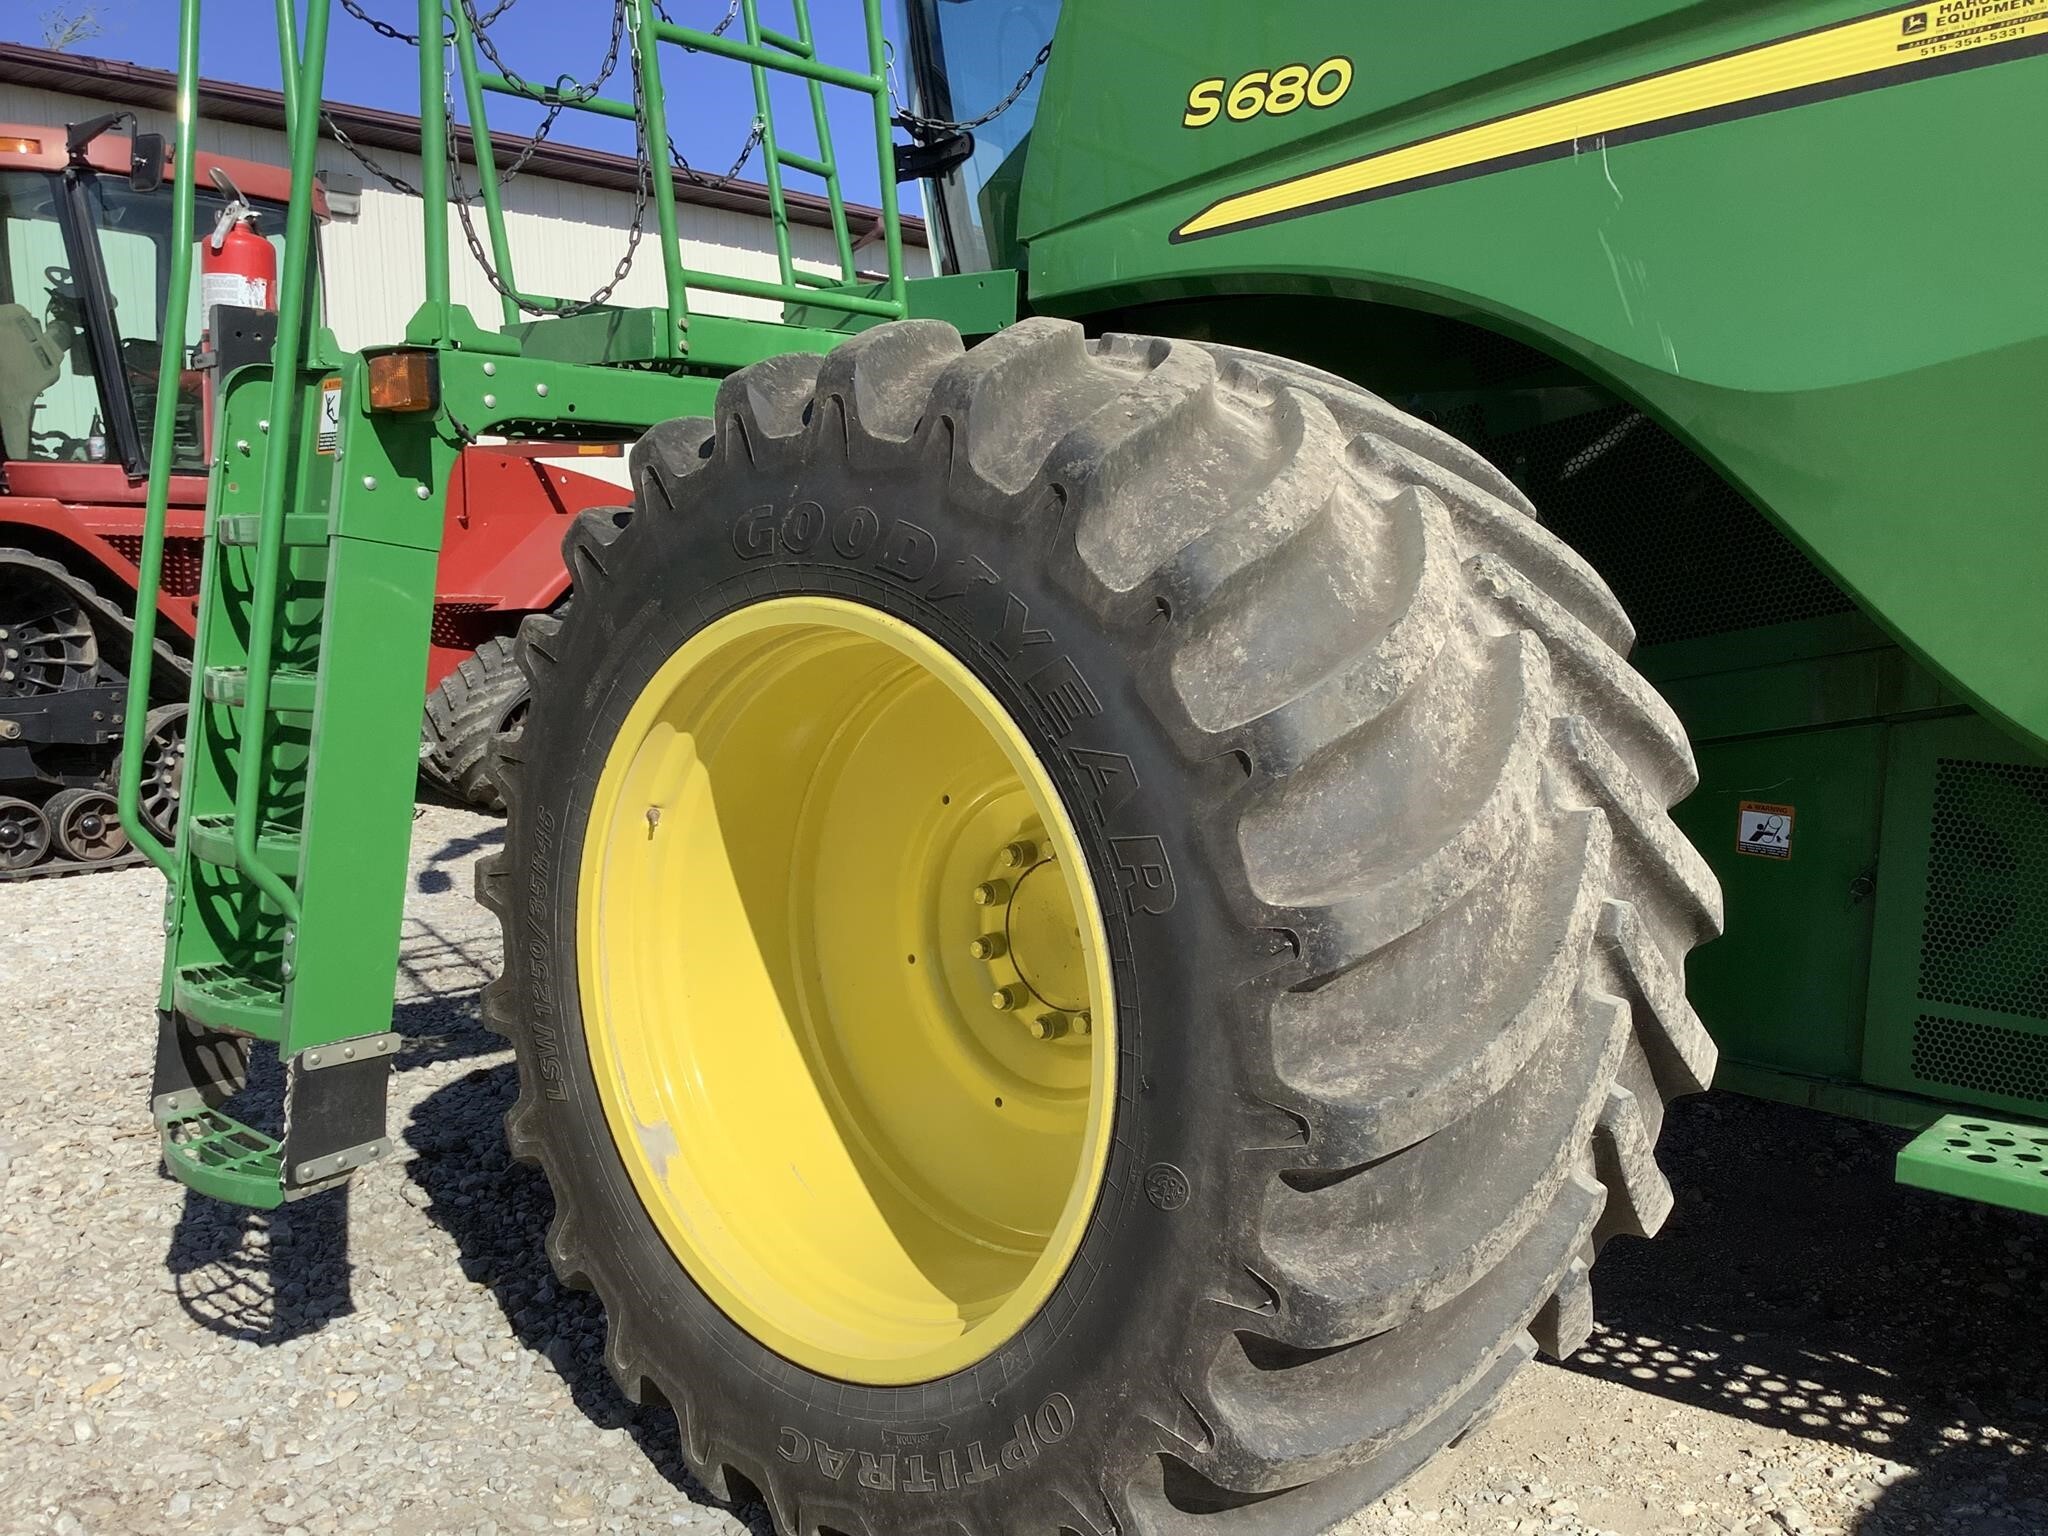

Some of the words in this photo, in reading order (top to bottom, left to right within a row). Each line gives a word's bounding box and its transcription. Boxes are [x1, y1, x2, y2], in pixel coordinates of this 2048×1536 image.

[1908, 37, 1939, 48] SALES
[1953, 27, 1984, 38] PARTS
[1999, 14, 2043, 27] SERVICE
[1936, 0, 2045, 27] EQUIPMEN
[1920, 26, 2026, 56] 515-354-5331
[1182, 55, 1354, 129] S680
[732, 500, 1177, 916] GOODYEAR
[1755, 804, 1788, 814] WARNING
[532, 1022, 569, 1103] LSW
[776, 1392, 1075, 1493] OPTITRAC
